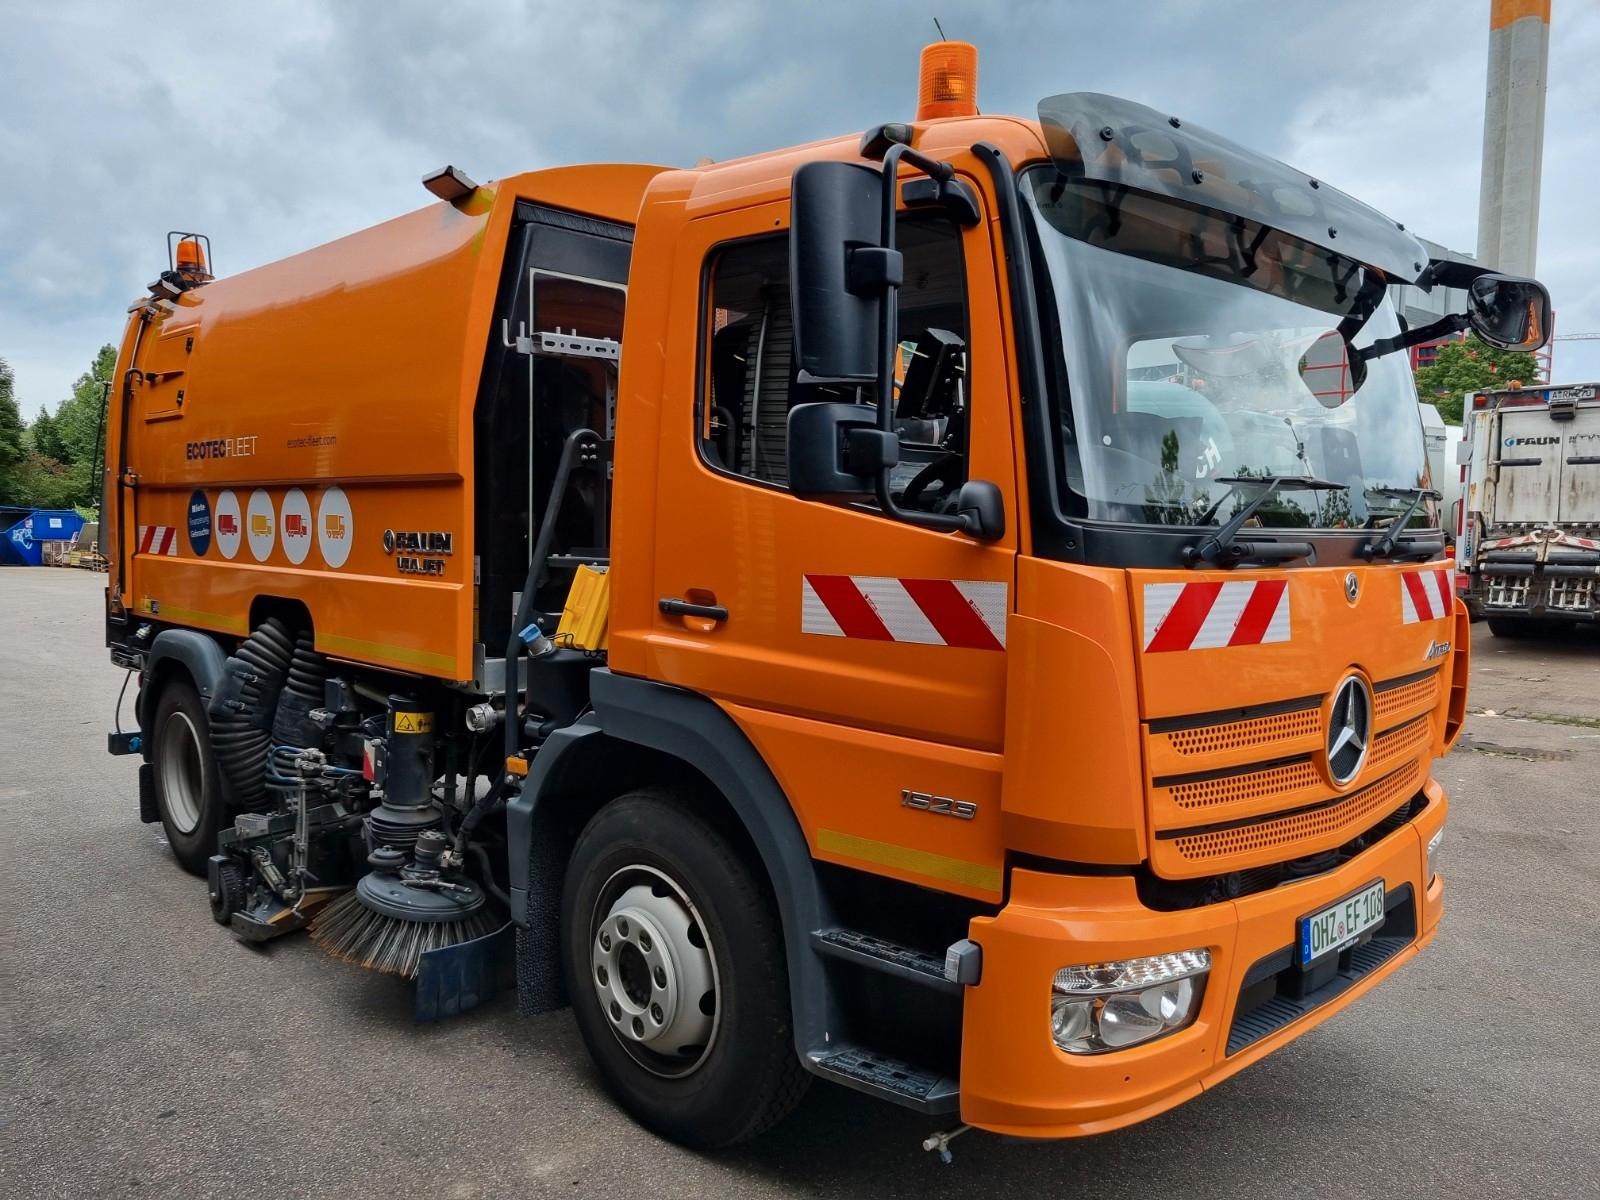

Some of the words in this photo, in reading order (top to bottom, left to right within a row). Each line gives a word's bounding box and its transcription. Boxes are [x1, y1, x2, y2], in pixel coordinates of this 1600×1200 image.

[186, 435, 258, 460] ECOTECFLEET
[1516, 436, 1560, 446] FAUN
[901, 789, 977, 819] 1523
[1312, 910, 1338, 953] OHZ
[1345, 898, 1361, 935] EF
[1363, 887, 1384, 925] 108
